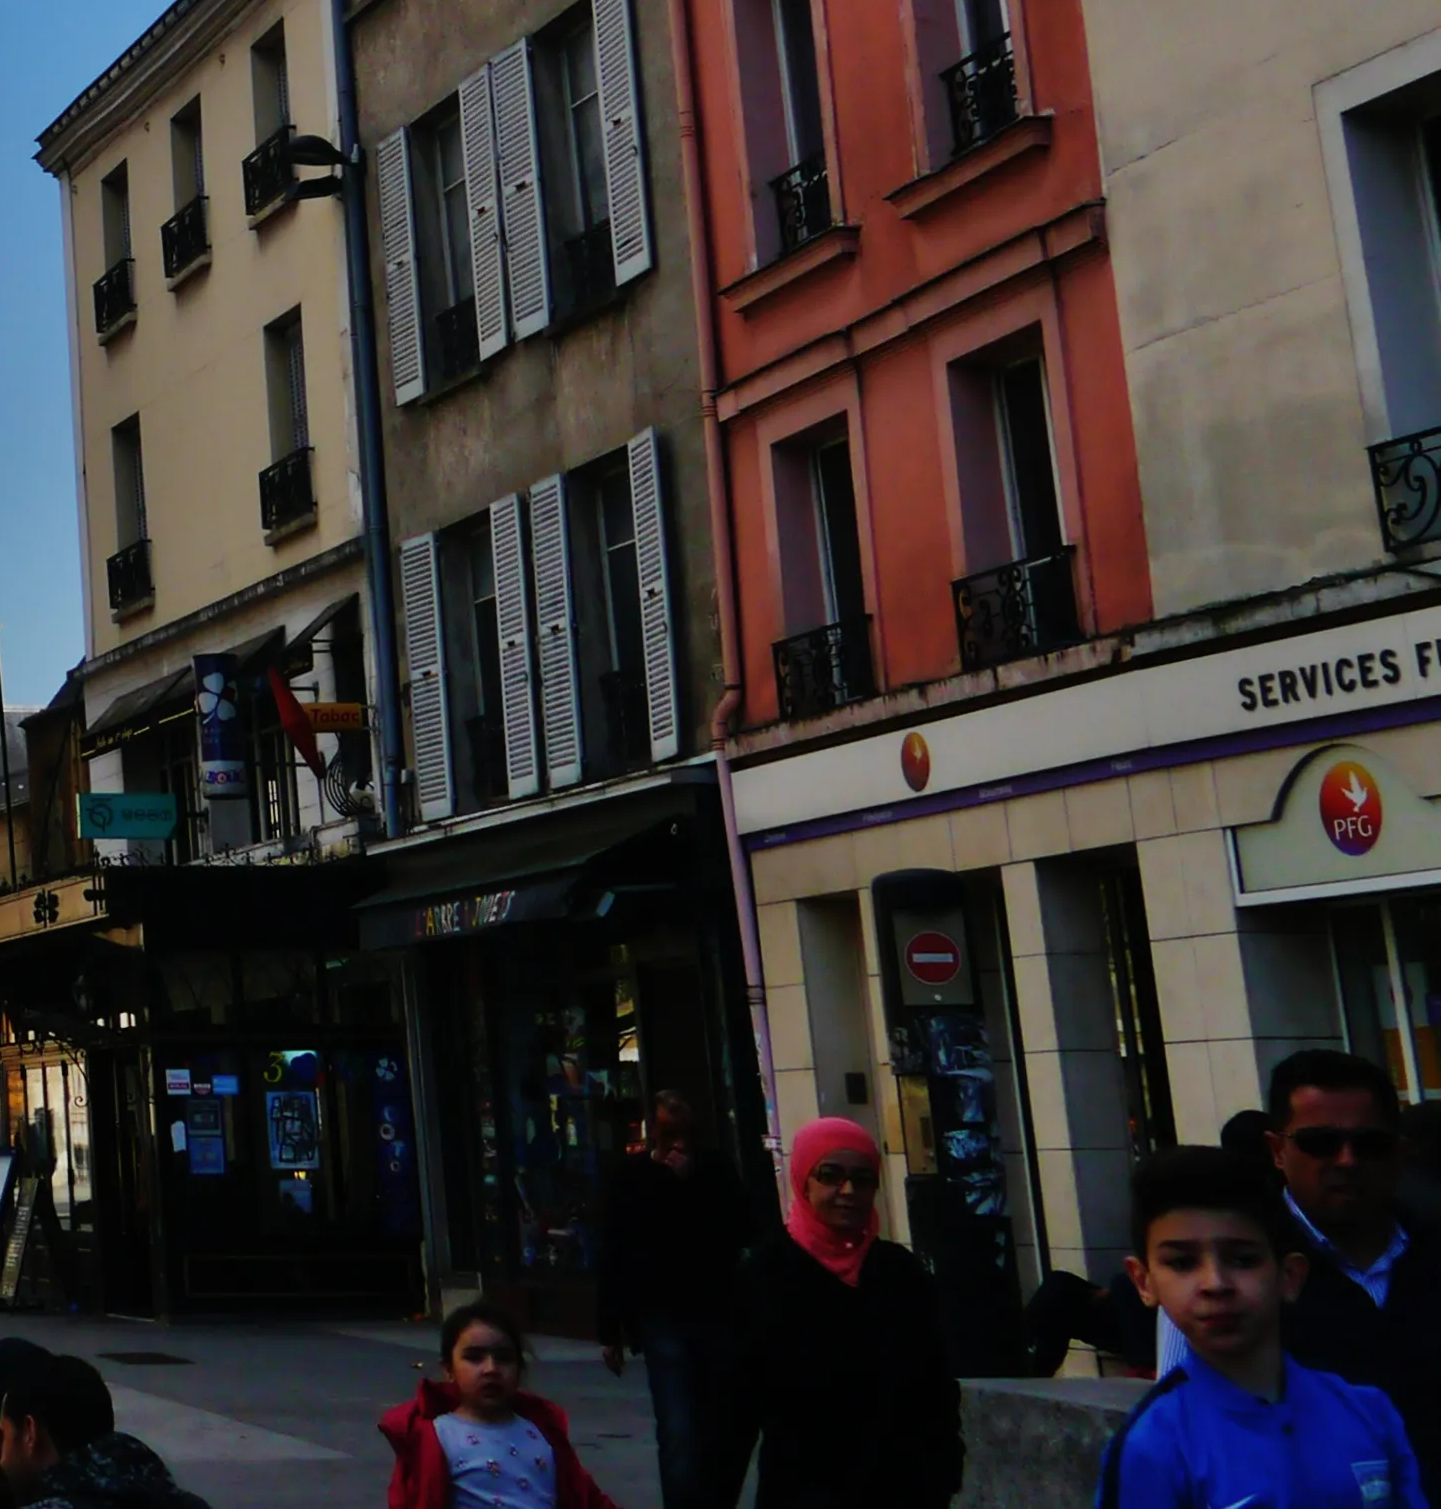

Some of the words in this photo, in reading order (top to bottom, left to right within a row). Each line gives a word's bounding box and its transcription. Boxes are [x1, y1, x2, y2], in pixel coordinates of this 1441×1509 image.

[1237, 648, 1402, 712] SERVICES
[311, 707, 360, 724] Tabac
[1332, 814, 1373, 841] PFG
